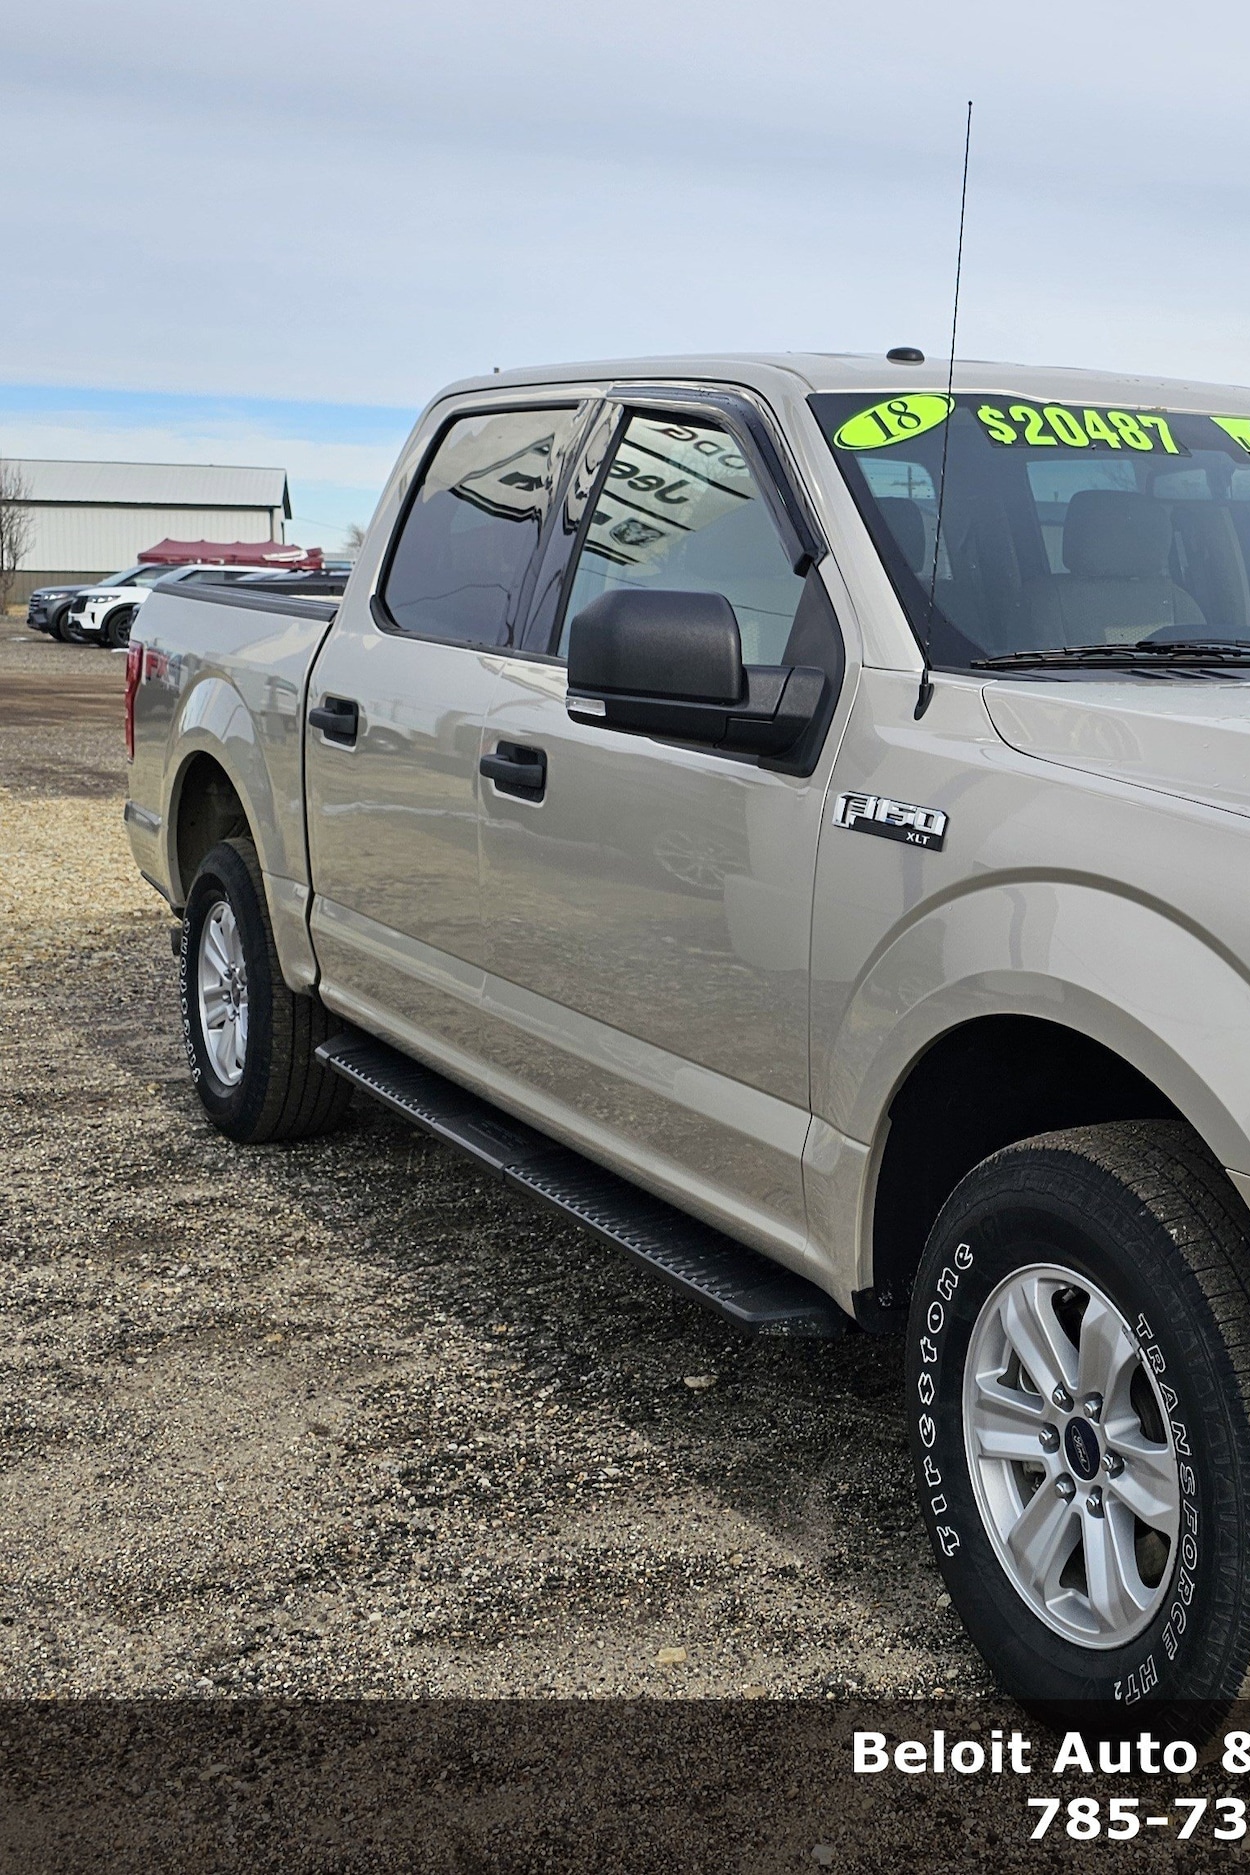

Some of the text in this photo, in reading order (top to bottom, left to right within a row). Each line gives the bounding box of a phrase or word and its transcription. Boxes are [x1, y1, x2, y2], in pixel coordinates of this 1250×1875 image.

[863, 400, 922, 442] 18
[976, 404, 1180, 455] $20487
[831, 790, 948, 837] F150
[905, 831, 931, 846] XLT
[917, 1242, 974, 1557] Firestone
[1135, 1312, 1199, 1662] TRANSFORCE
